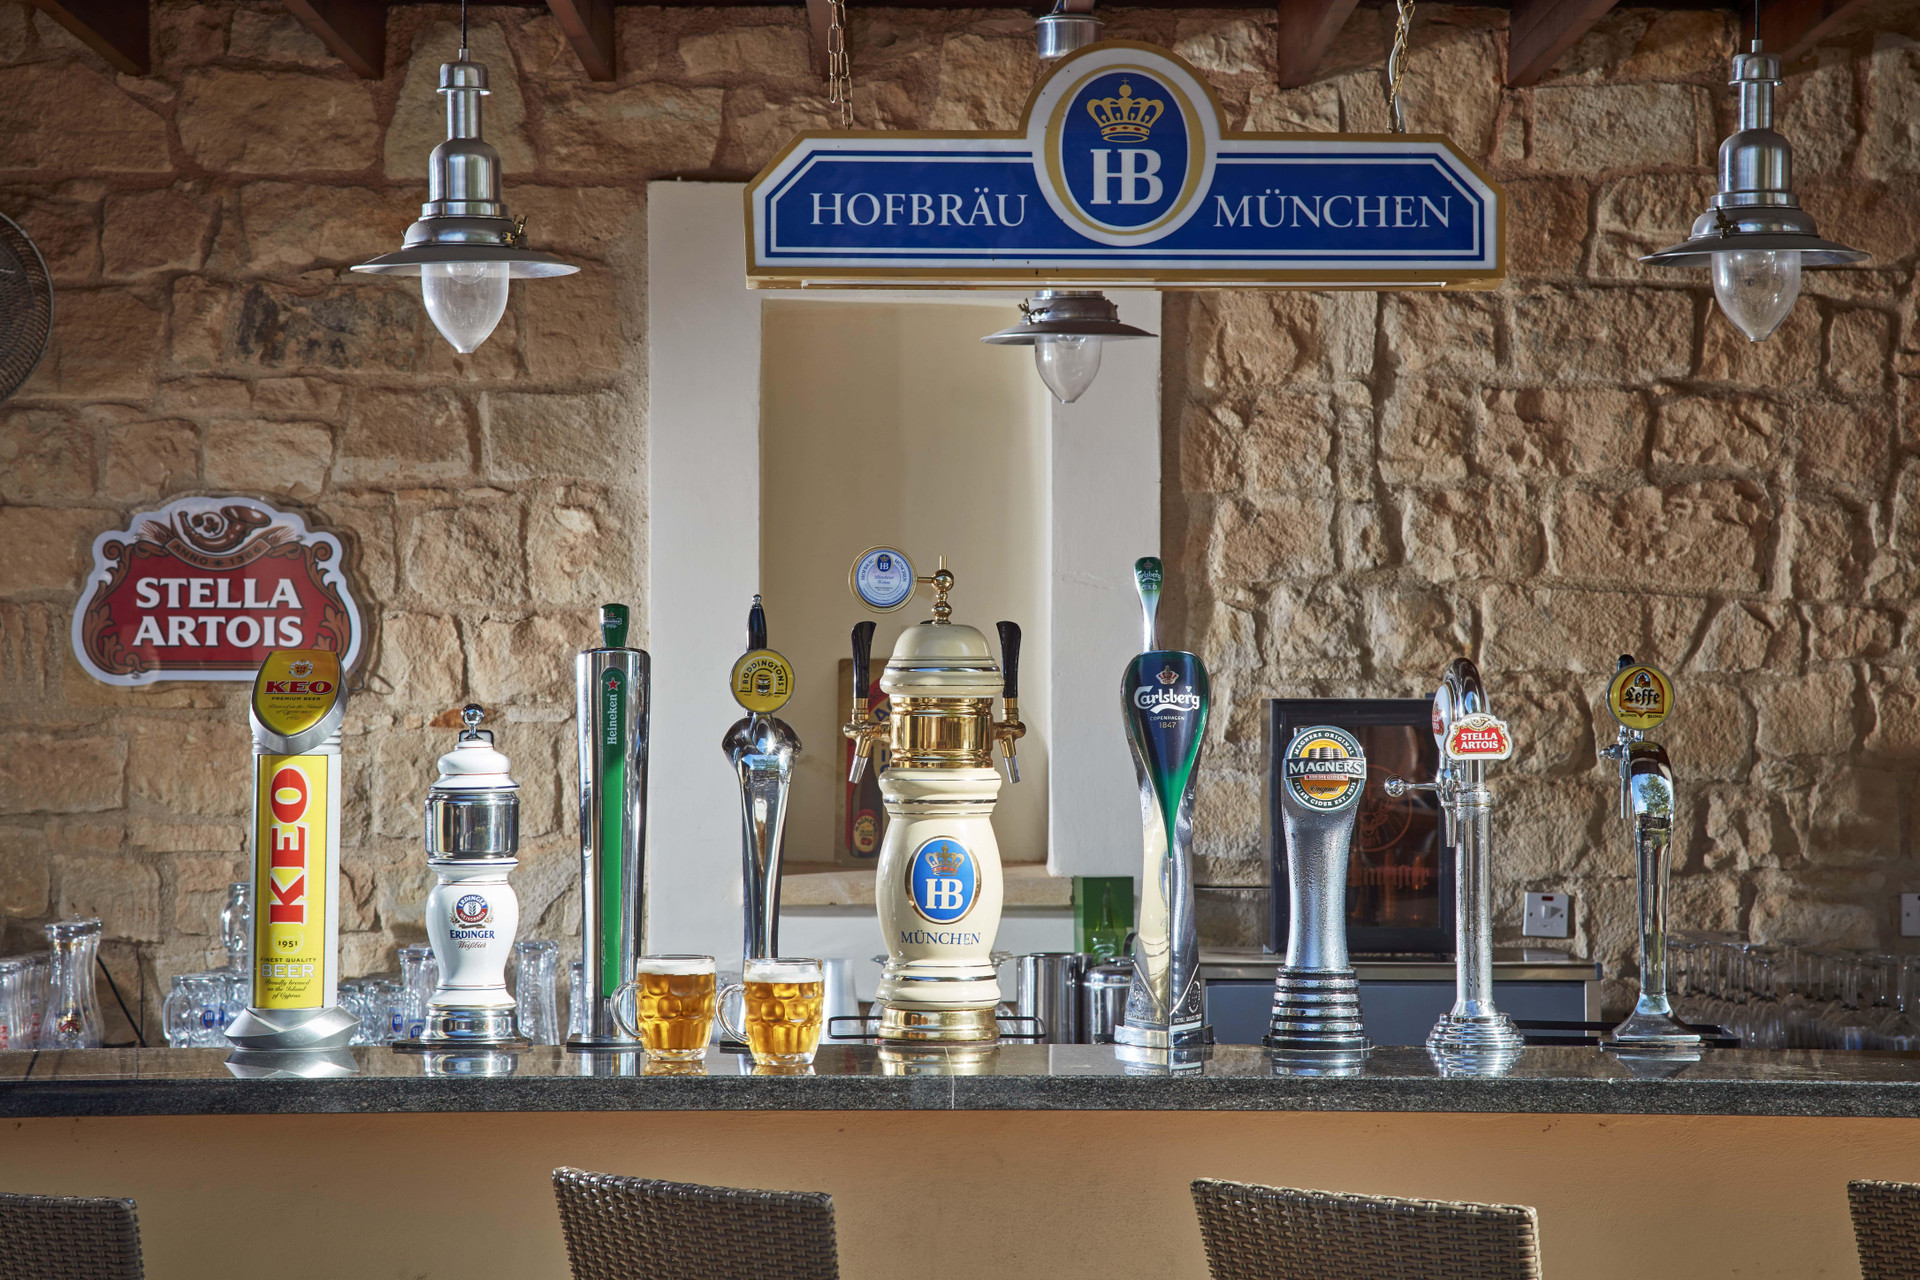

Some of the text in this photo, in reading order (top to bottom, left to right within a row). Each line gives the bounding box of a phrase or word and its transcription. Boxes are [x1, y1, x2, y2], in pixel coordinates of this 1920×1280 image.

[1090, 148, 1164, 205] HB
[810, 187, 1452, 229] HOFBRÄU MÜNCHEN
[174, 544, 208, 566] ANNO
[135, 577, 303, 609] STELLA
[132, 615, 304, 648] ARTOIS
[742, 660, 784, 687] BODDINGTONS
[264, 680, 334, 695] KEO
[1623, 686, 1660, 708] Leffe
[1133, 685, 1200, 714] Carlsberg
[606, 694, 618, 745] Heineken
[1159, 721, 1177, 729] 1847
[1294, 733, 1355, 755] MAGNERS ORIGINAL
[1461, 733, 1498, 741] STELLA
[1461, 741, 1499, 749] ARTOIS
[1289, 761, 1363, 775] MAGNERS
[1295, 782, 1309, 800] IRISH
[1310, 798, 1333, 806] CIDER
[1334, 796, 1348, 805] EST.
[1310, 785, 1340, 796] Original
[269, 766, 308, 925] KEO
[458, 896, 486, 907] ERDINGER
[925, 878, 964, 910] HB
[278, 940, 298, 948] 1951
[449, 930, 495, 939] ERDINGER
[901, 930, 981, 945] MÜNCHEN
[261, 963, 315, 978] BEER
